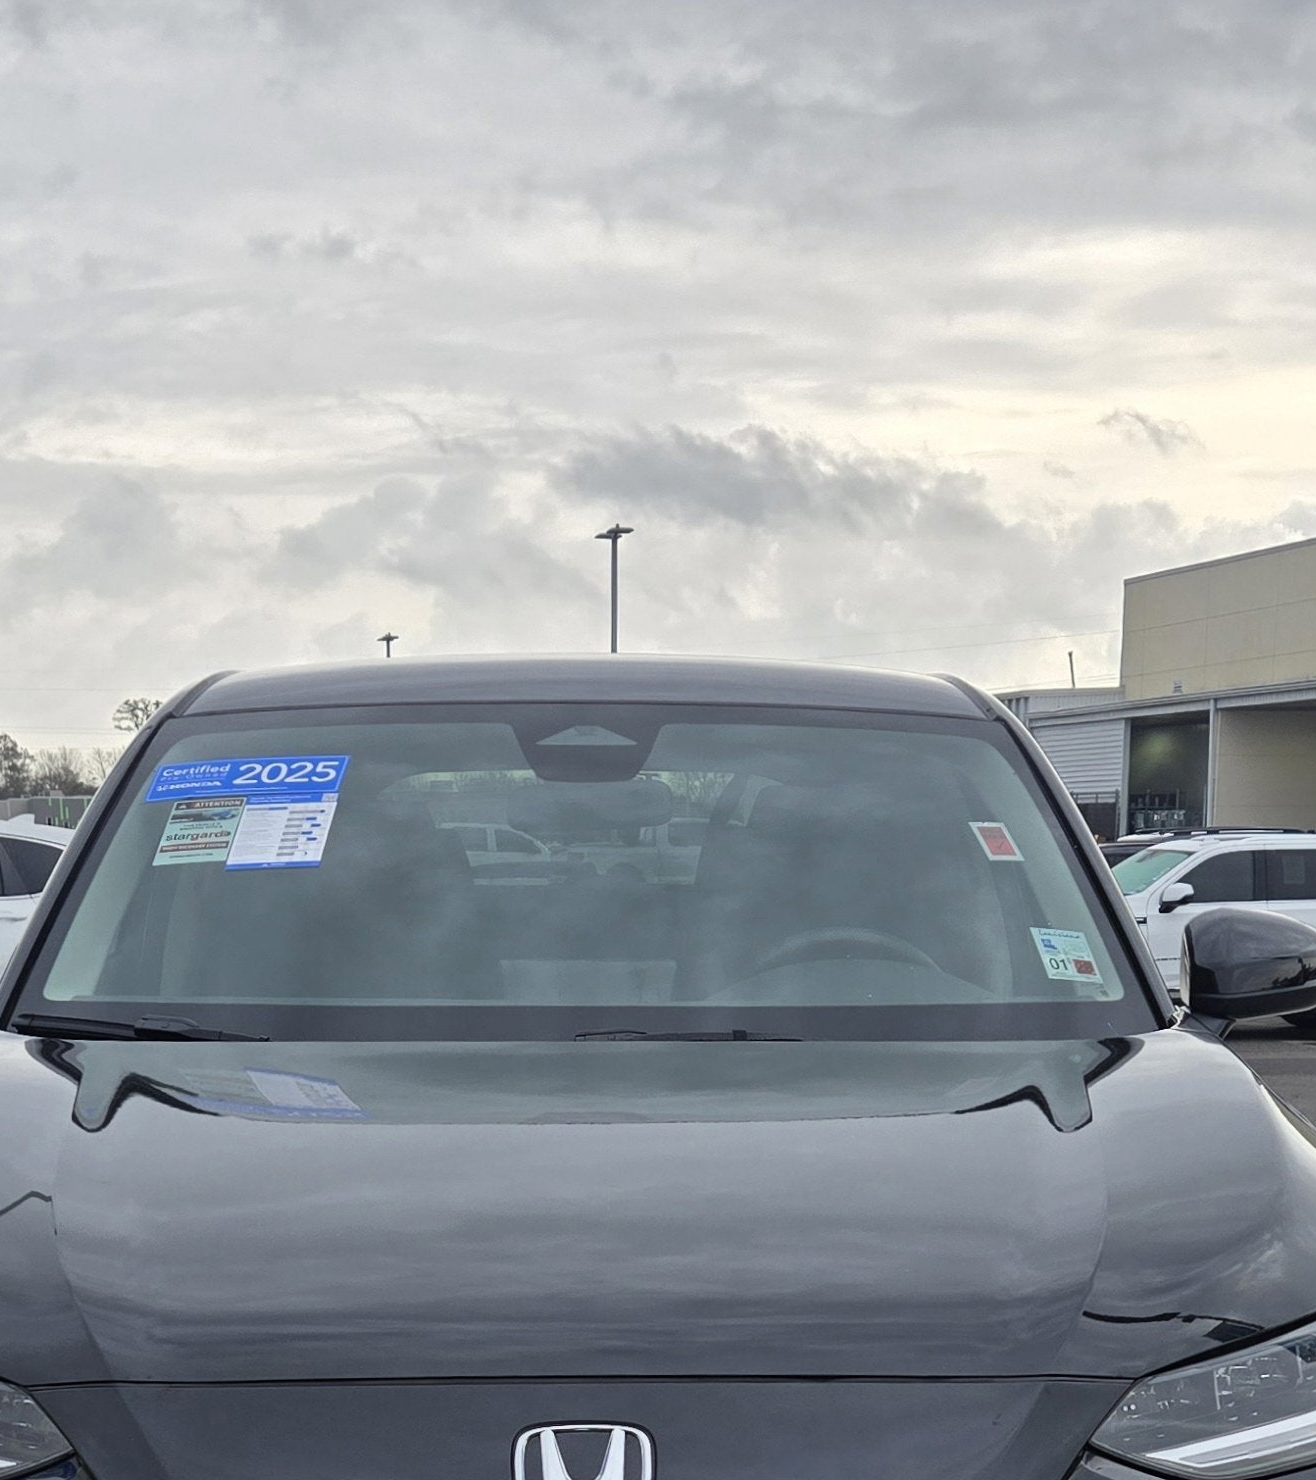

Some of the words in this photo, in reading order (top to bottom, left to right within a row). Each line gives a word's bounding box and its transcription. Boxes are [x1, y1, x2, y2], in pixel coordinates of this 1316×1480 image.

[162, 763, 231, 777] Certified
[232, 761, 340, 785] 2025
[193, 800, 242, 808] ATTENTION
[1049, 957, 1069, 971] 01
